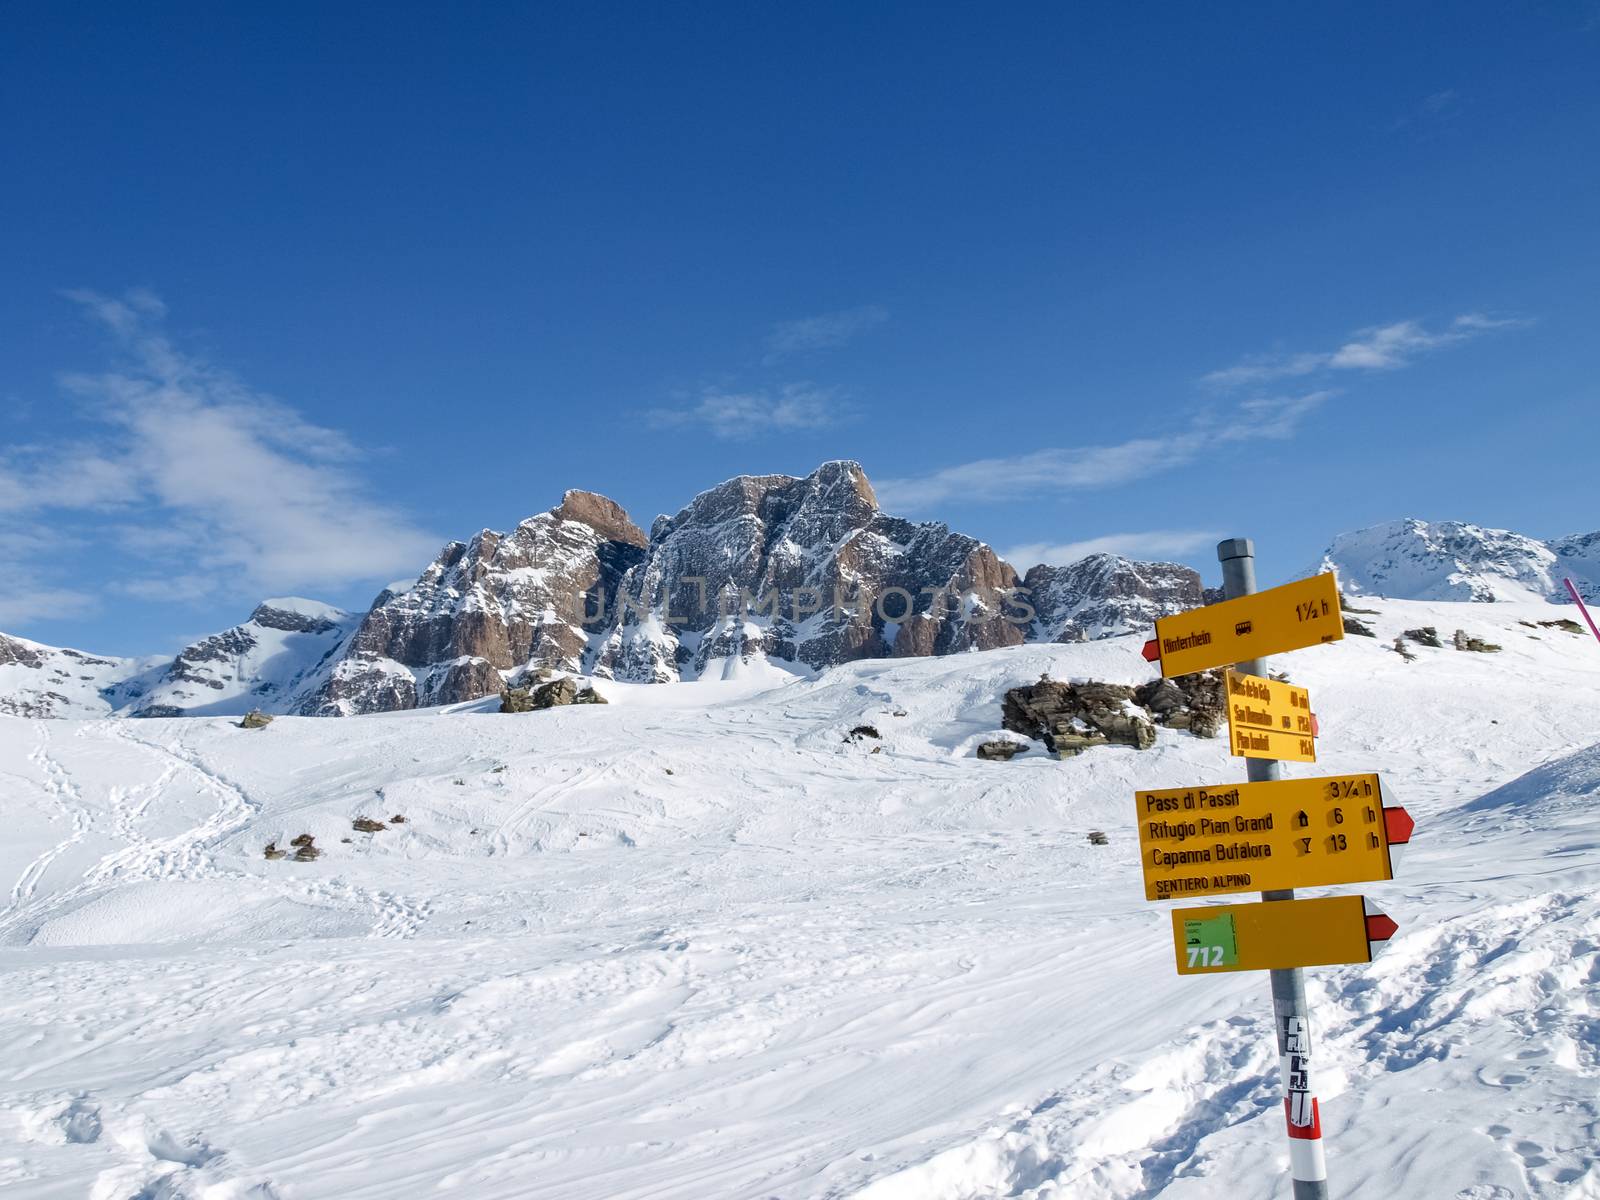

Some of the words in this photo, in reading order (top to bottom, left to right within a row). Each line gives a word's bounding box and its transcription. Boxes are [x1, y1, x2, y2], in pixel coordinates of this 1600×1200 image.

[1163, 629, 1212, 654] Hinterrhein
[1322, 600, 1329, 616] h
[1146, 795, 1179, 812] Pass
[1184, 792, 1196, 809] di
[1199, 789, 1240, 808] Passit
[1364, 780, 1372, 796] h
[1149, 821, 1196, 841] Rifugio
[1201, 818, 1230, 835] Pian
[1235, 813, 1273, 832] Grand
[1334, 808, 1344, 824] 6
[1368, 806, 1376, 822] h
[1153, 848, 1211, 869] Capanna
[1216, 842, 1272, 861] Bufalora
[1330, 834, 1347, 850] 13
[1371, 832, 1379, 848] h
[1156, 877, 1209, 893] SENTIERO
[1213, 873, 1251, 889] ALPINO
[1186, 945, 1224, 968] 712
